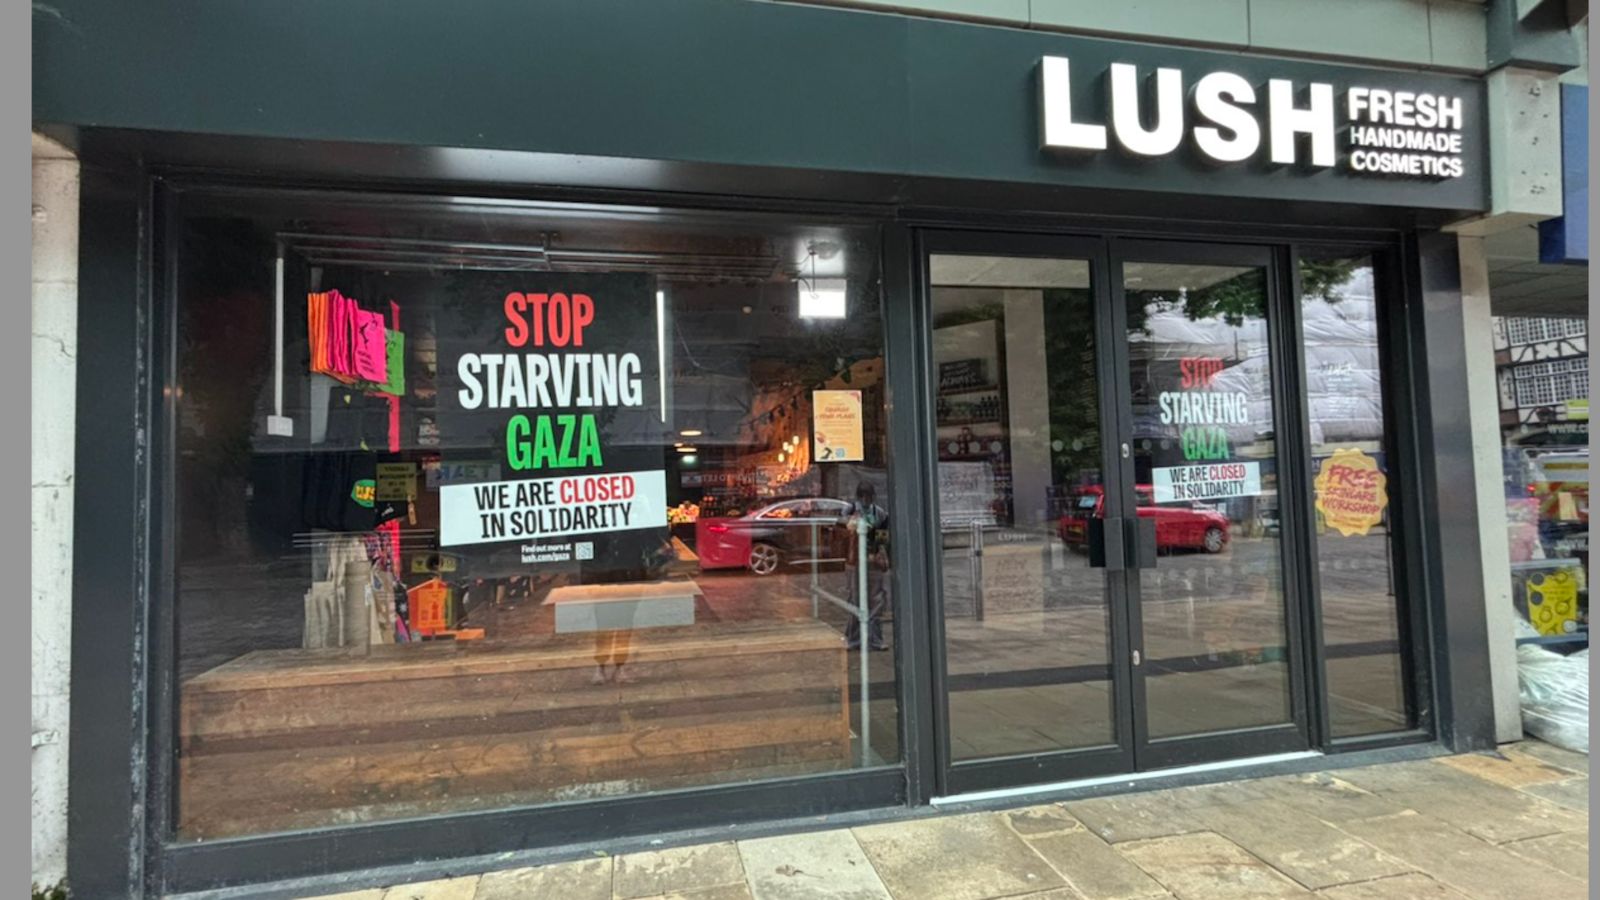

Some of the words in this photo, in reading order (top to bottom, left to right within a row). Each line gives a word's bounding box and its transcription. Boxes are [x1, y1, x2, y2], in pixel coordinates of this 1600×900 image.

[1040, 55, 1336, 168] LUSH
[1348, 86, 1462, 130] FRESH
[1350, 126, 1462, 154] HANDMADE
[1350, 150, 1464, 178] COSMETICS
[504, 291, 595, 347] STOP
[457, 352, 643, 410] STARVING
[1179, 356, 1225, 389] STOP
[1159, 391, 1249, 425] STARVING
[506, 414, 603, 471] GAZA
[1183, 427, 1229, 460] GAZA
[1169, 467, 1187, 483] WE
[1189, 466, 1208, 481] ARE
[1209, 464, 1245, 480] CLOSED
[1172, 484, 1185, 499] IN
[1186, 481, 1245, 498] SOLIDARITY
[1327, 464, 1379, 488] FREE
[474, 482, 510, 511] WE
[515, 480, 556, 507] ARE
[559, 475, 635, 504] CLOSED
[1323, 497, 1380, 514] WORKSHOP
[480, 512, 505, 539] IN
[510, 502, 632, 537] SOLIDARITY
